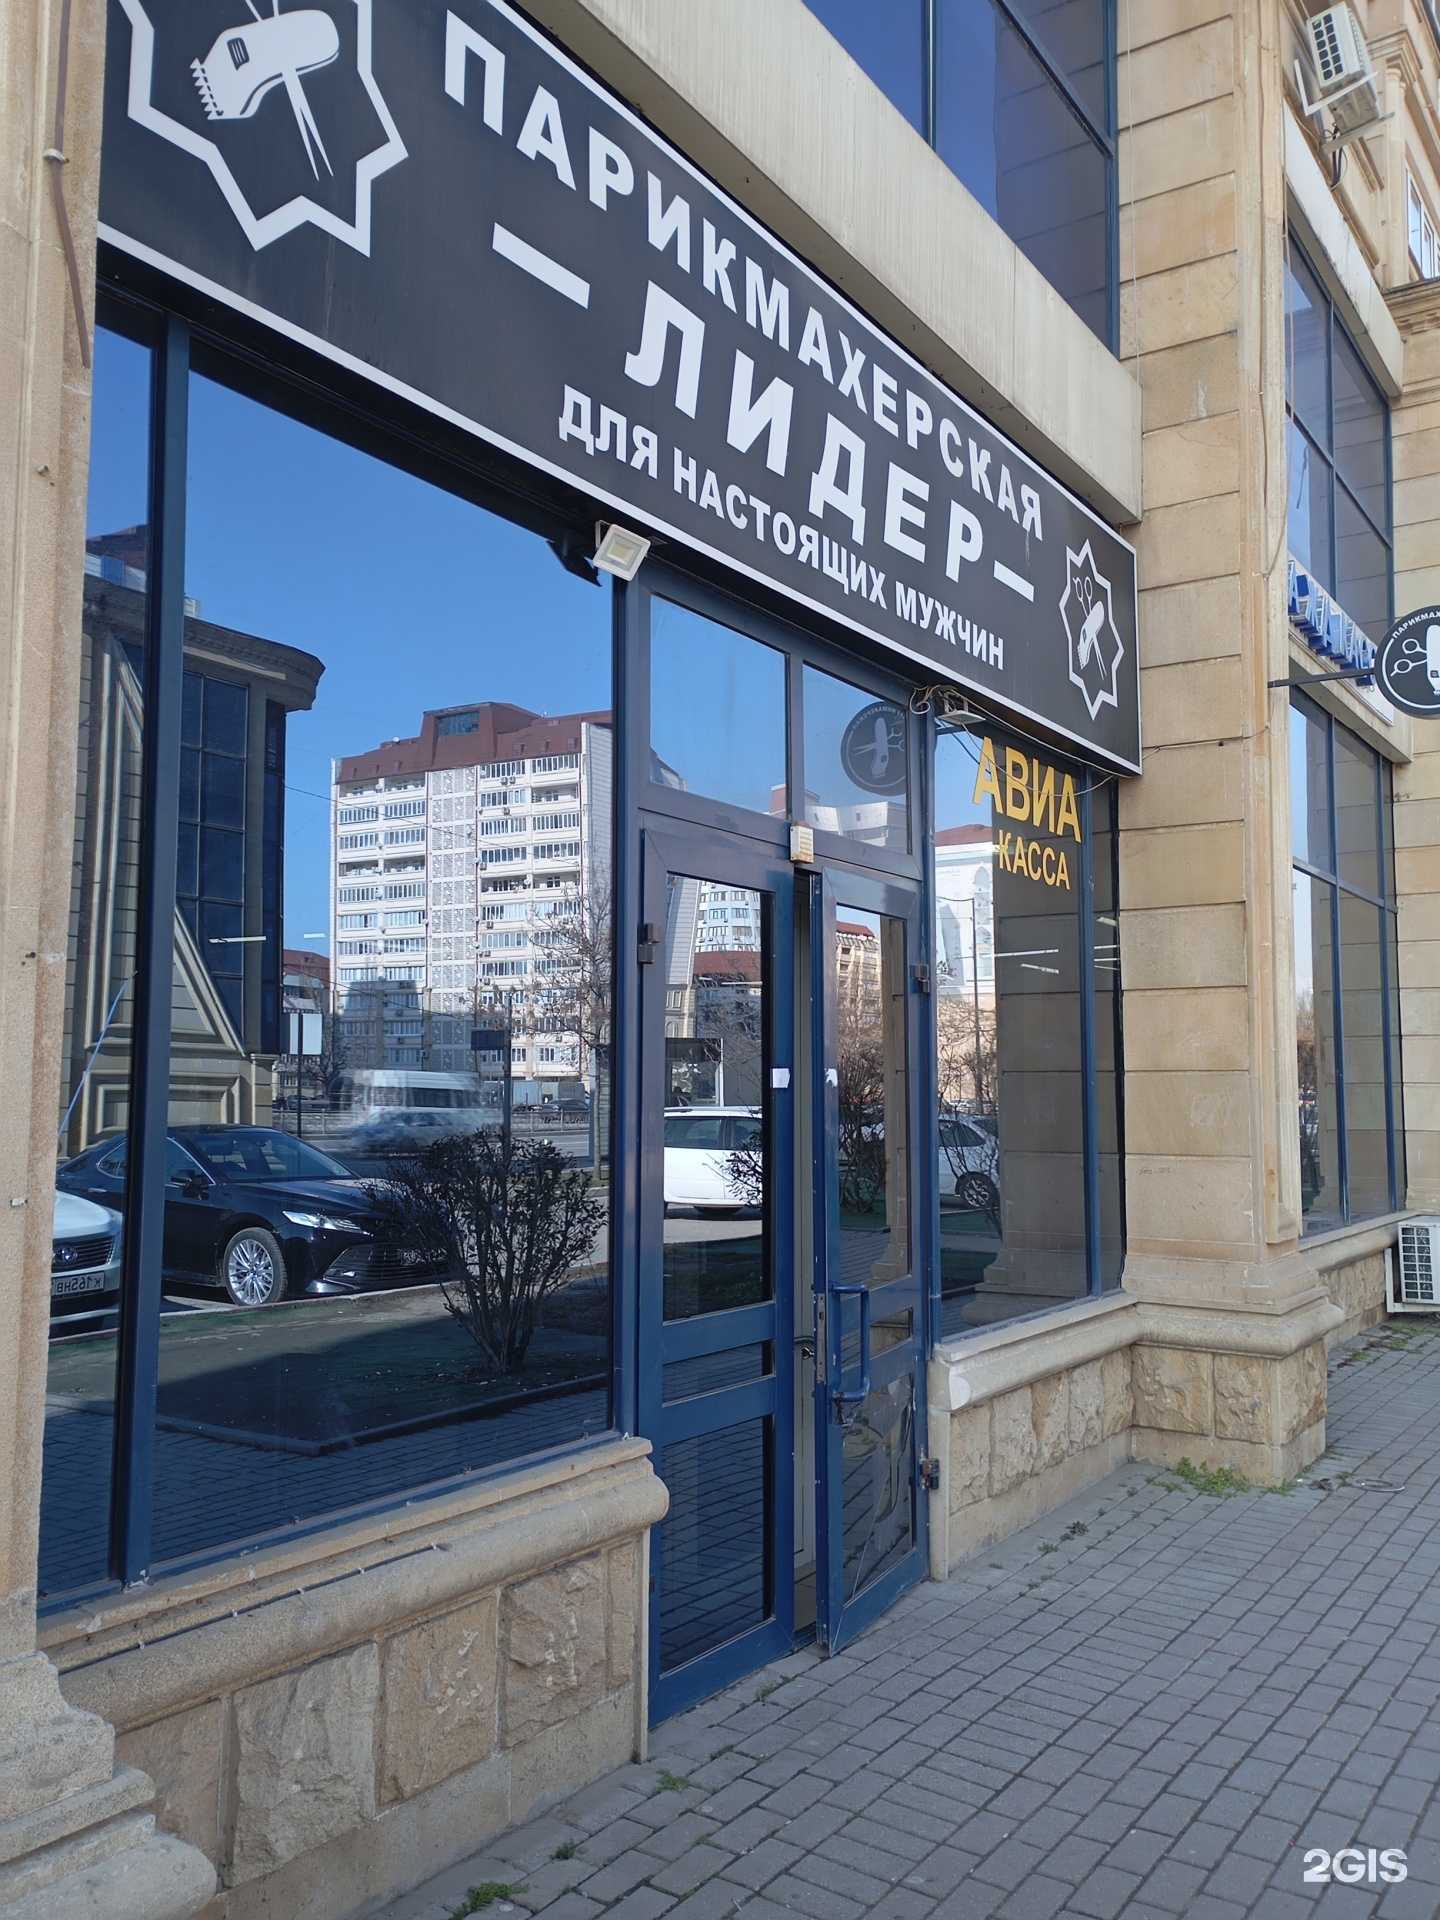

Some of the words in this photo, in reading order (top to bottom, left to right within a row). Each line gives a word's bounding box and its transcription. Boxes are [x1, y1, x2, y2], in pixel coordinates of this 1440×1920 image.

[445, 9, 1043, 541] ПАРИКМАХЕРСКАЯ
[559, 385, 658, 478] ДЛЯ
[673, 446, 886, 610] НАСТОЯЩИХ
[895, 588, 1005, 670] МУЖЧИН
[624, 280, 984, 583] ЛИДЕР
[972, 735, 1082, 843] АВИА
[998, 829, 1071, 890] КАССА
